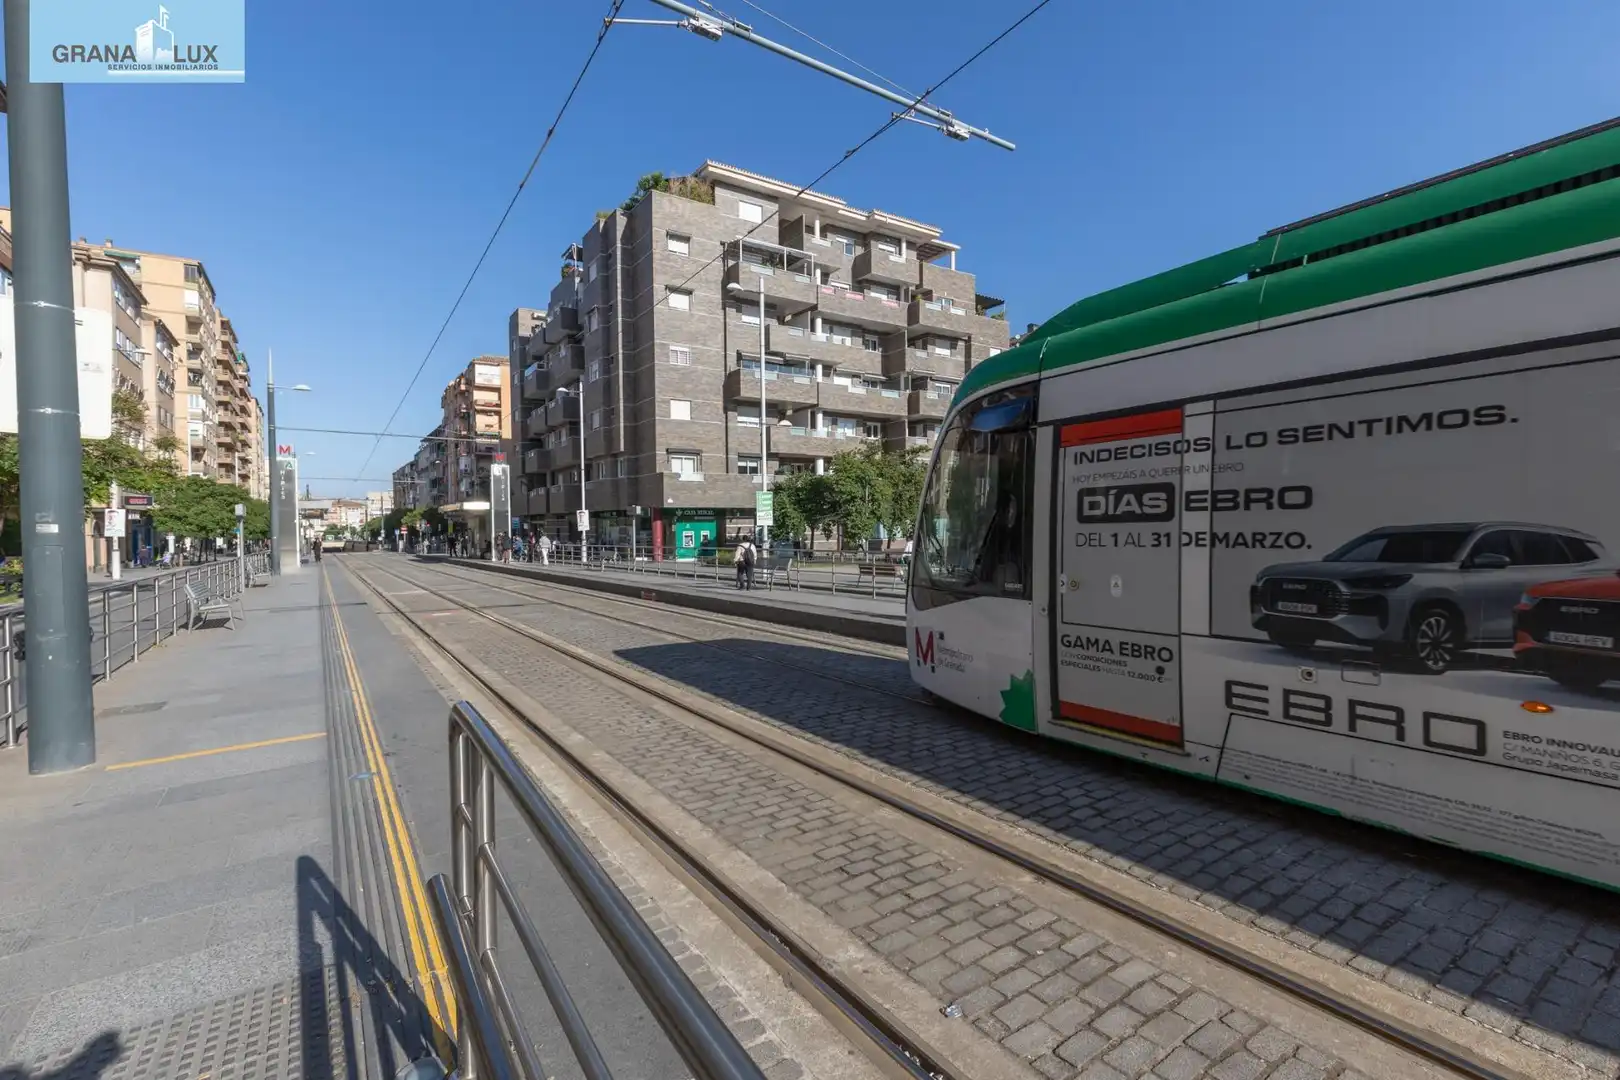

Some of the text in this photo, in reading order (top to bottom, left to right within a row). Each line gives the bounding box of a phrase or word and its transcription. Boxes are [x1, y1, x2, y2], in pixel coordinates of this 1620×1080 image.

[1225, 431, 1268, 450] LO
[1276, 404, 1520, 446] SENTIMOS.
[1072, 473, 1092, 485] HOY
[1139, 470, 1148, 479] A
[1193, 463, 1210, 474] UN
[1082, 485, 1313, 516] DÍAS EBRO
[1075, 531, 1312, 550] DEL 1 AL 31 DE MARZO.
[1060, 633, 1174, 663] GAMA EBRO
[1060, 659, 1101, 673] ESPECIALES
[1076, 653, 1128, 668] CONDICIONES
[1224, 679, 1487, 757] EBRO
[1502, 730, 1543, 744] EBRO
[1502, 752, 1544, 768] Grupo
